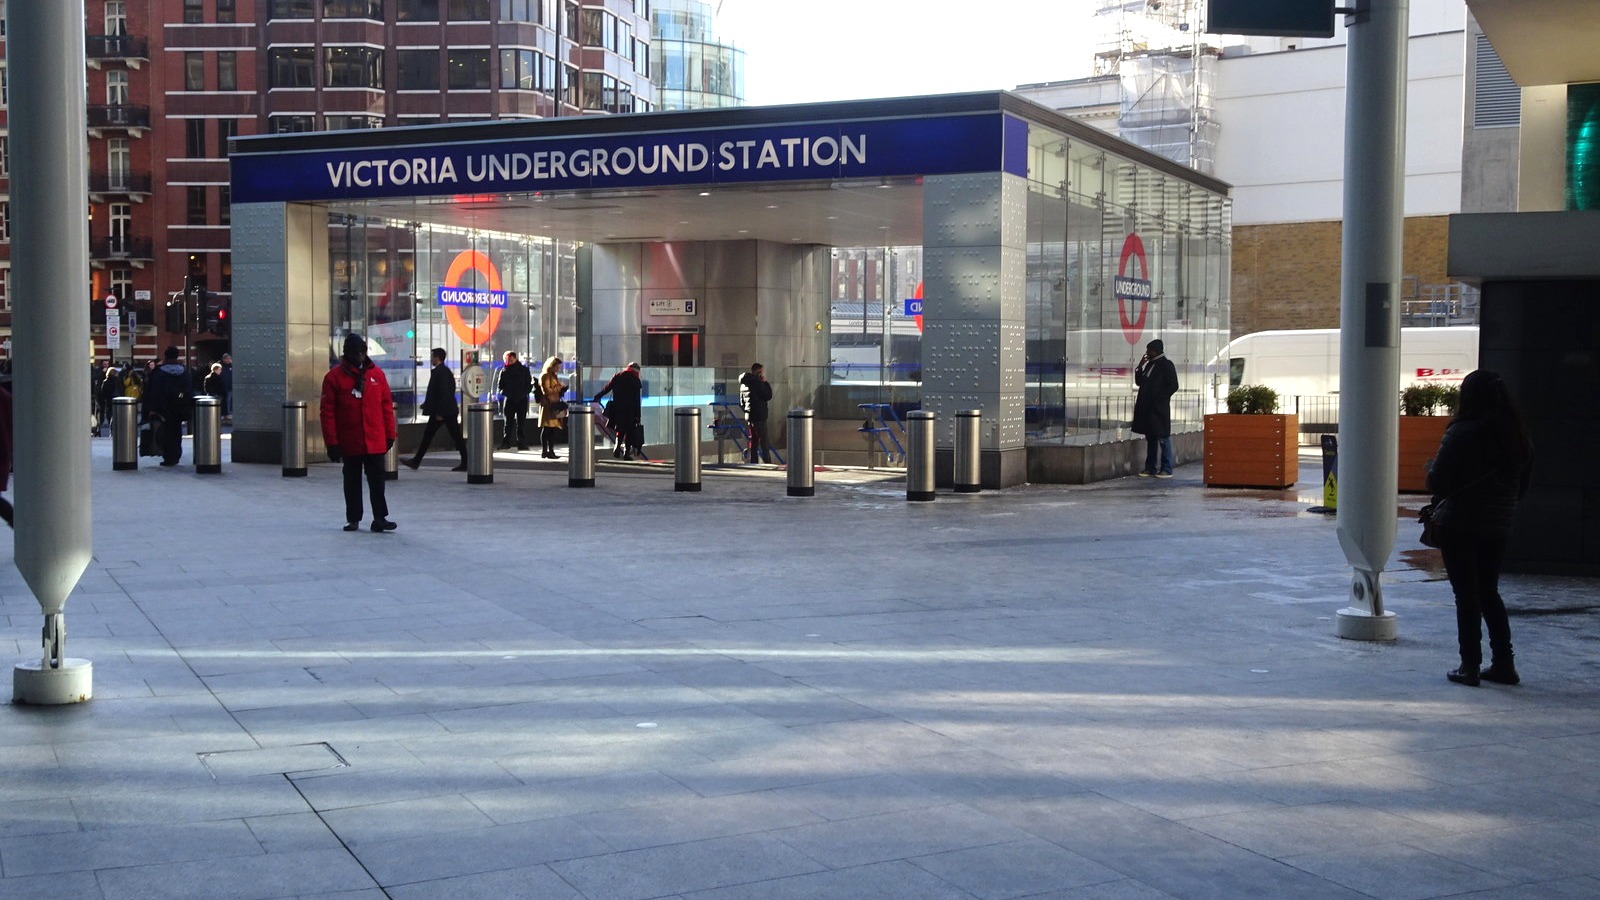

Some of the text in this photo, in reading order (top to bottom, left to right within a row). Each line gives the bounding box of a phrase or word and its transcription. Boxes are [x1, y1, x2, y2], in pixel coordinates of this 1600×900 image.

[326, 134, 866, 188] VICTORIA UNDERGROUND STATION
[1115, 280, 1151, 297] UNDERGROUND
